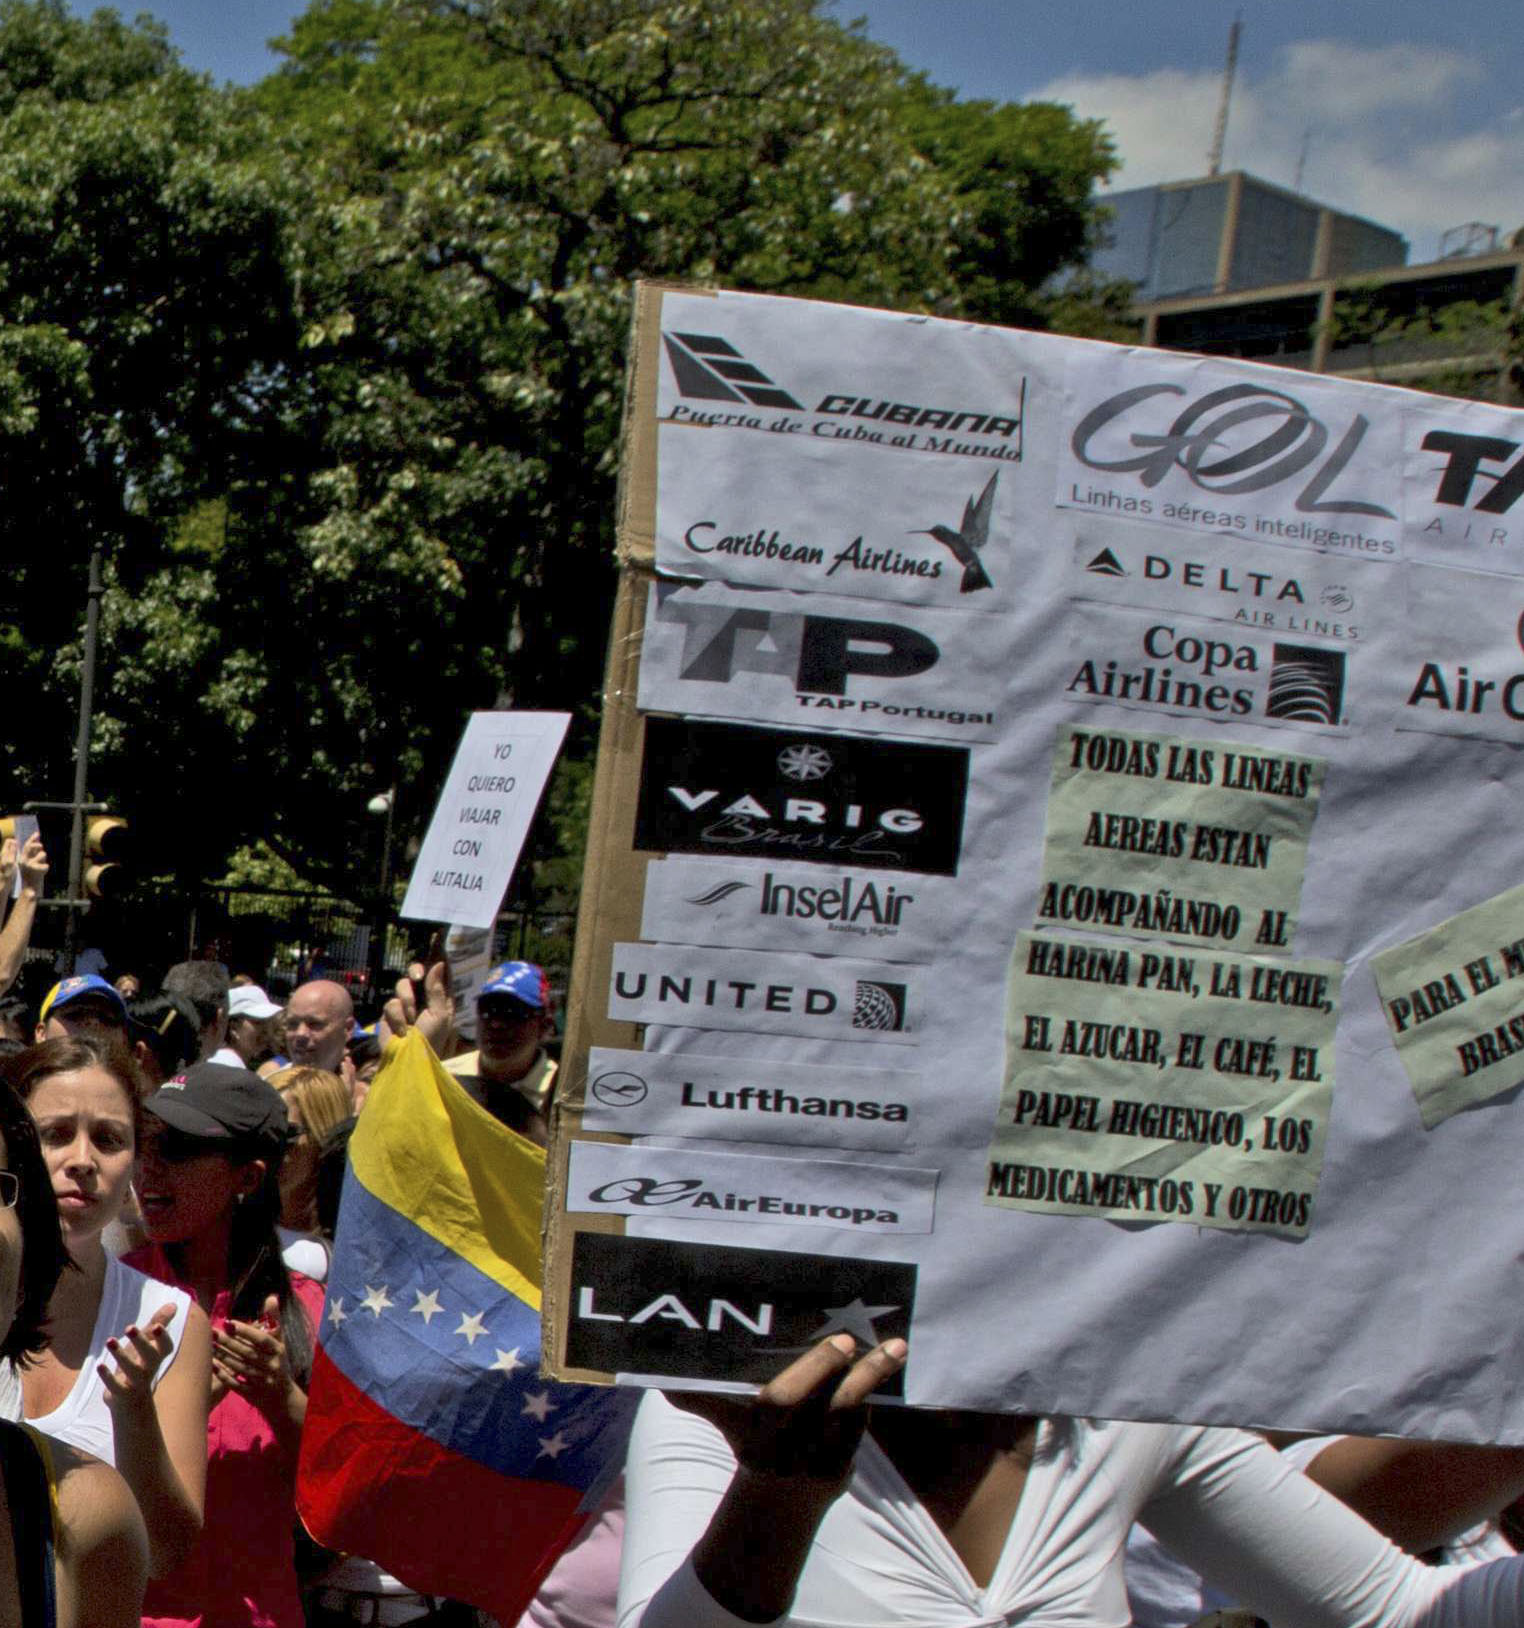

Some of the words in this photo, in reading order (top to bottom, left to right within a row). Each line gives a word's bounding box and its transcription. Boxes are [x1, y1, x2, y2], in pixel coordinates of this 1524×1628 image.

[669, 404, 761, 431] Puerta
[770, 416, 803, 435] de
[811, 421, 884, 444] Cuba
[891, 430, 916, 448] al
[920, 436, 1021, 461] Mundo
[815, 394, 1020, 438] CUBANA
[1071, 382, 1399, 520] GOL
[1071, 484, 1153, 515] Linhas
[1162, 502, 1247, 531] aéreas
[1255, 514, 1395, 555] inteligentes
[684, 521, 824, 565] Caribbean
[827, 535, 943, 579] Airlines
[1144, 555, 1305, 603] DELTA
[657, 600, 940, 695] TAP
[1143, 625, 1259, 676] Copa
[795, 695, 855, 712] TAP
[856, 699, 994, 726] Portugal
[1066, 659, 1254, 715] Airlines
[494, 743, 512, 760] YO
[1070, 731, 1160, 779] TODAS
[1164, 745, 1215, 785] LAS
[1221, 752, 1312, 799] LINEAS
[467, 775, 516, 793] QUIERO
[667, 786, 924, 833] VARIG
[459, 807, 502, 826] VIAJAR
[1083, 811, 1188, 858] AEREAS
[1190, 824, 1272, 870] ESTAN
[452, 839, 482, 857] CON
[430, 870, 483, 891] ALITALIA
[760, 873, 914, 925] InselAir
[1039, 882, 1241, 941] ACOMPAÑANDO
[1255, 909, 1290, 947] AL
[615, 971, 838, 1016] UNITED
[1026, 939, 1129, 987] HARINA
[1137, 953, 1199, 998] PAN,
[1209, 961, 1242, 1000] LA
[1249, 965, 1333, 1014] LECHE,
[1388, 972, 1468, 1033] PARA
[1463, 955, 1501, 996] EL
[1022, 1014, 1053, 1052] EL
[1059, 1018, 1167, 1070] AZUCAR,
[1175, 1032, 1205, 1070] EL
[1213, 1035, 1280, 1083] CAFÉ,
[1289, 1045, 1322, 1082] EL
[680, 1082, 908, 1123] Lufthansa
[1013, 1089, 1101, 1133] PAPEL
[1262, 1116, 1313, 1154] LOS
[987, 1161, 1194, 1215] MEDICAMENTOS
[1202, 1182, 1222, 1218] Y
[1228, 1185, 1311, 1227] OTROS
[578, 1287, 773, 1336] LAN
